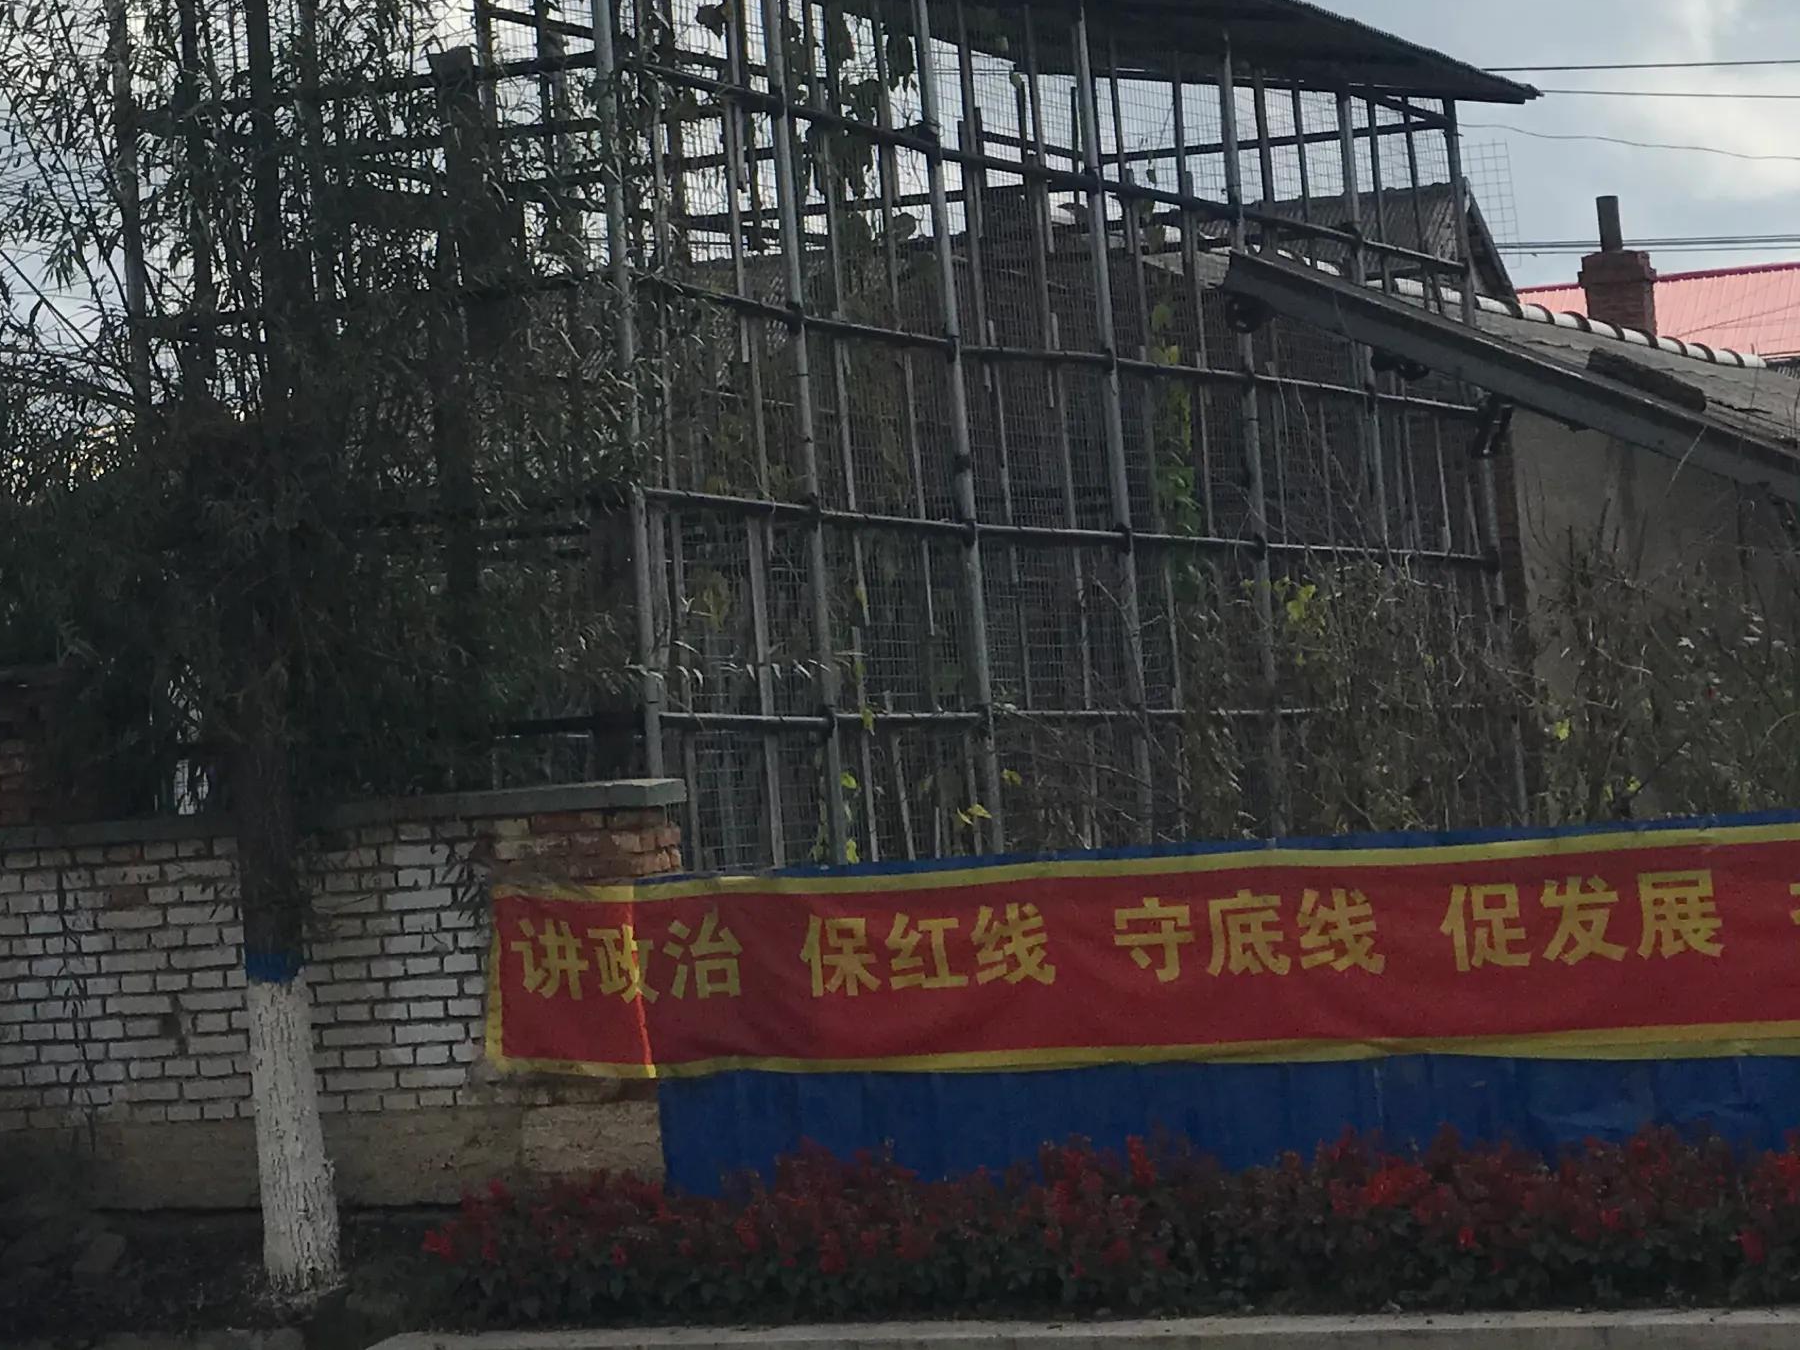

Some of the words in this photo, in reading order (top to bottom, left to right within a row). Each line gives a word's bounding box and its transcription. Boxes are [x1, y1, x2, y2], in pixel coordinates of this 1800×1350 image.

[511, 906, 743, 1004] 讲政治
[800, 901, 1057, 999] 保红线
[1113, 887, 1387, 983] 守底线
[1440, 868, 1725, 973] 促发展
